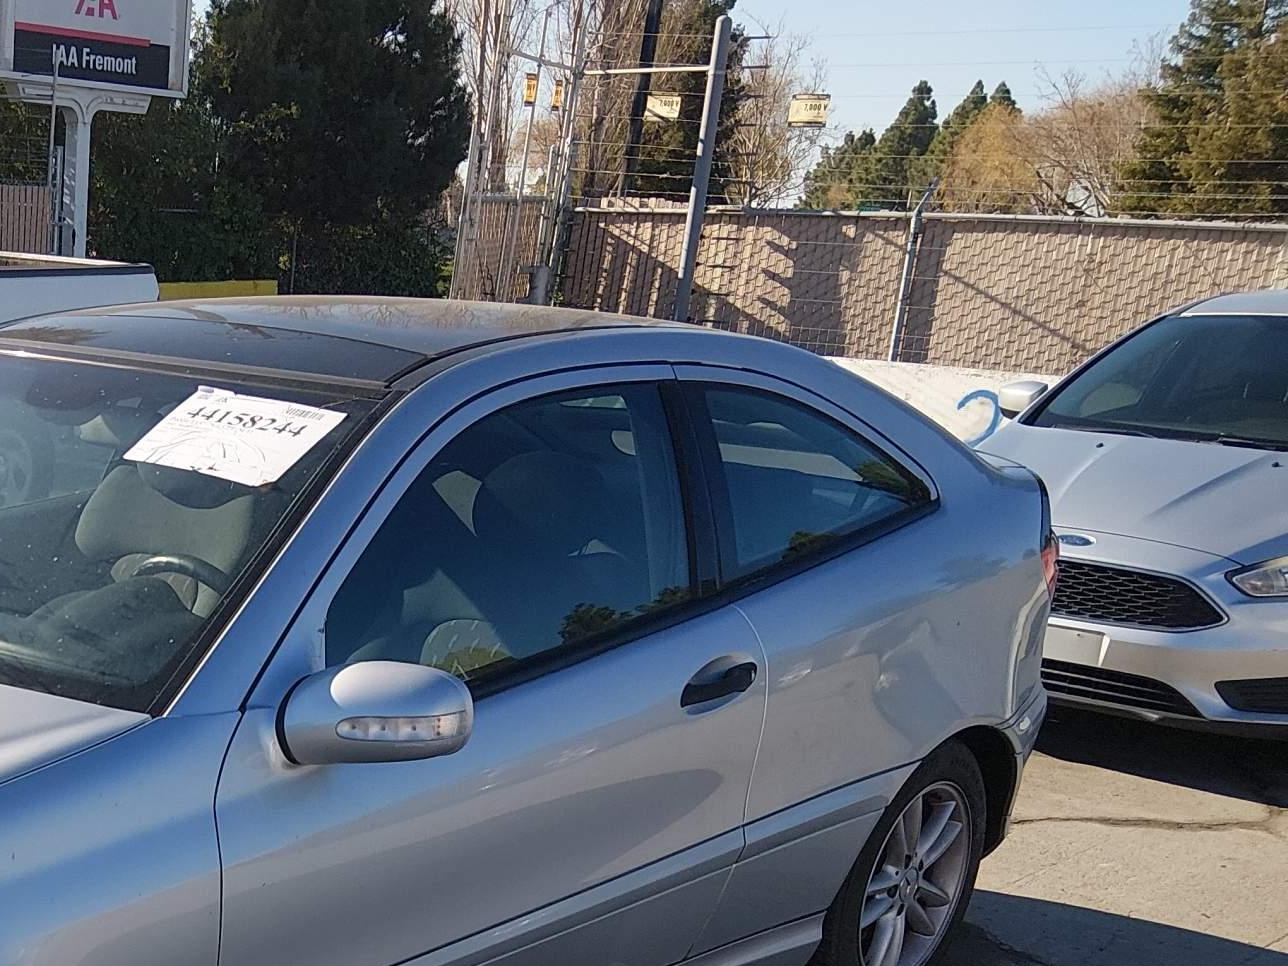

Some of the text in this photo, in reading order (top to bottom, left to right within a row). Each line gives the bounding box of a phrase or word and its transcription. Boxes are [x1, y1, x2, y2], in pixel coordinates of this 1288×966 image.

[52, 43, 136, 75] IAA Fremont
[804, 103, 822, 112] 7,000
[186, 405, 309, 438] 44158244
